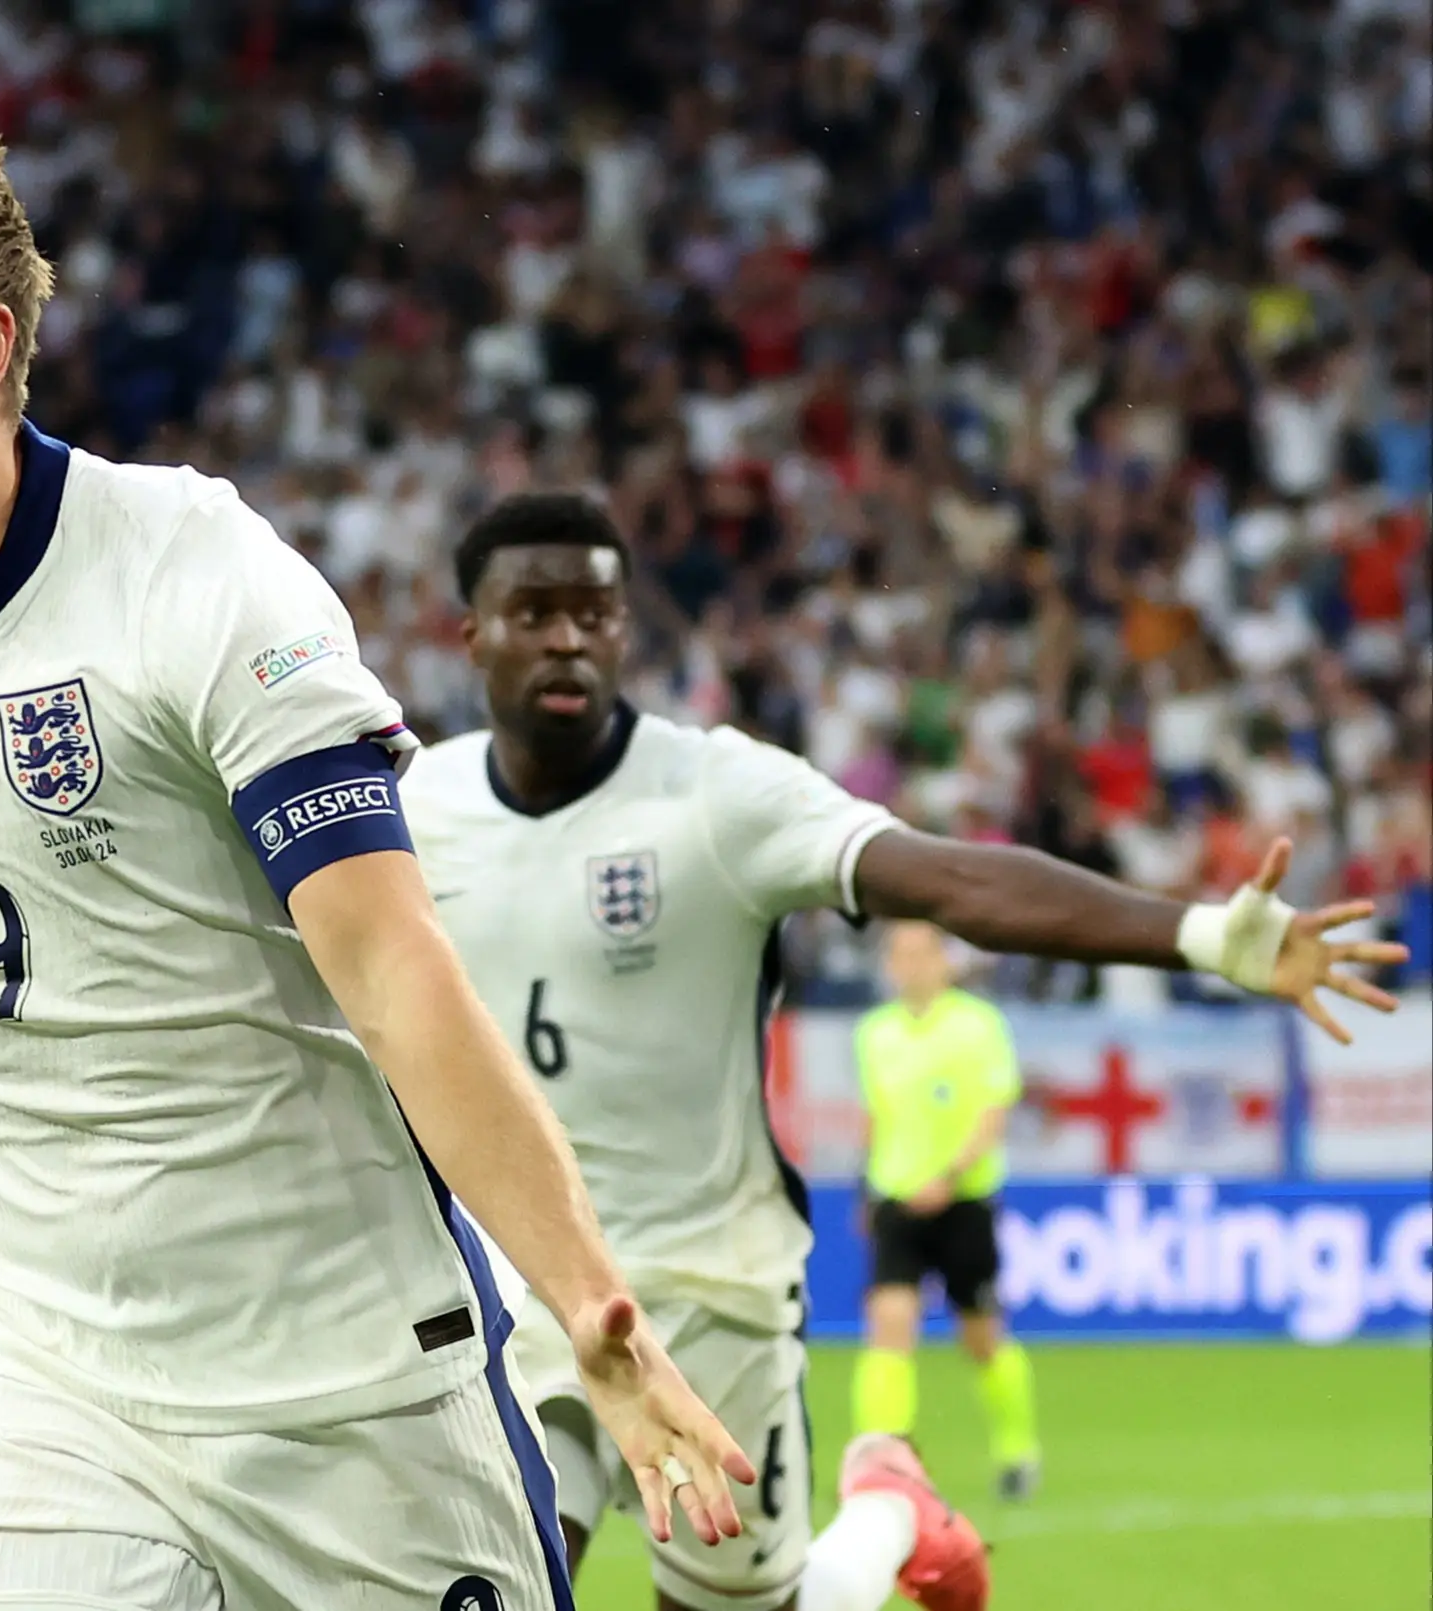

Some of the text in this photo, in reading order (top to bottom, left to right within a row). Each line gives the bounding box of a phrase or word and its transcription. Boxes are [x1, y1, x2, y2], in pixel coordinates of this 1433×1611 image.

[255, 635, 336, 686] FOUNDAT
[286, 785, 390, 830] RESPECT
[40, 817, 115, 849] SLOVAKIA
[525, 977, 570, 1079] 6
